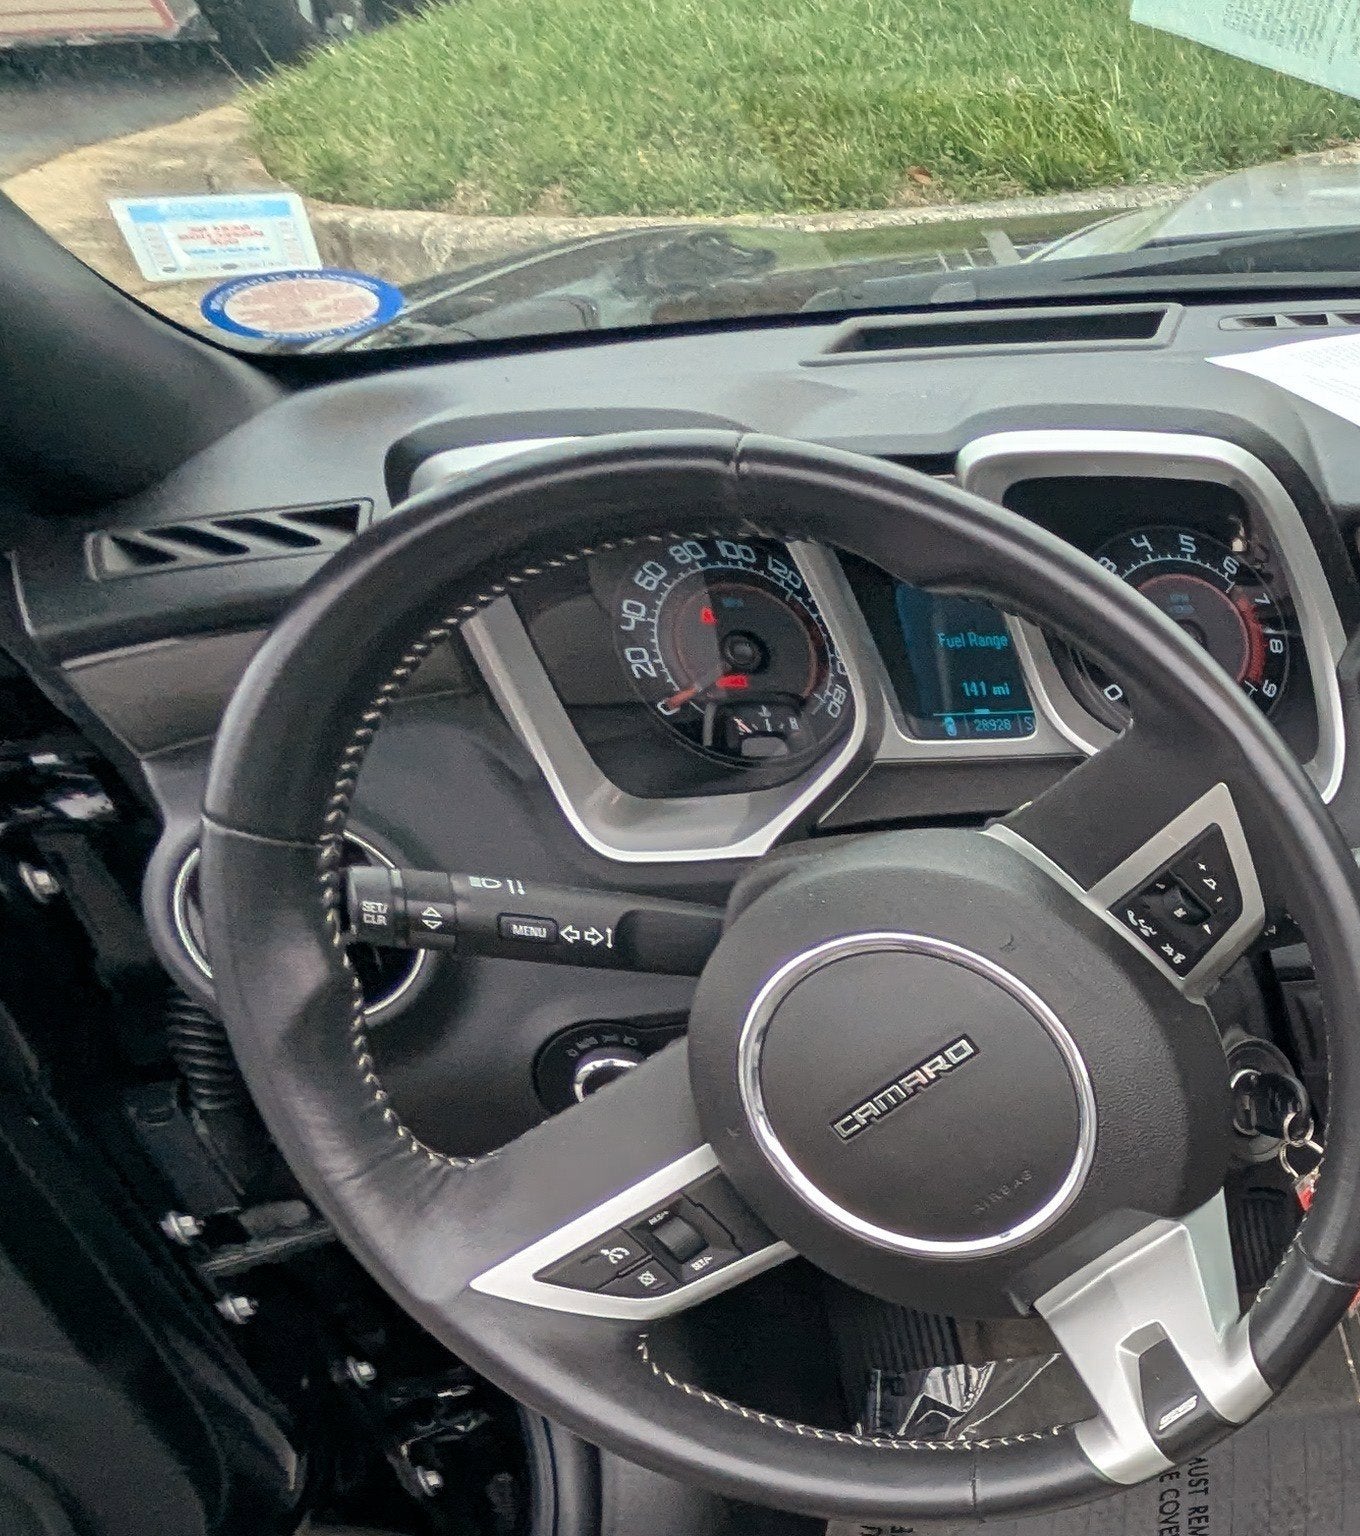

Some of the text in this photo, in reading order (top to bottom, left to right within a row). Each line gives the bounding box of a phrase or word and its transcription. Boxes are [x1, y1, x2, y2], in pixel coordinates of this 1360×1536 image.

[669, 540, 706, 564] 80
[716, 540, 756, 563] 100
[1130, 534, 1154, 552] 4
[1178, 533, 1196, 553] 5
[767, 556, 802, 590] 120
[1222, 555, 1241, 576] 6
[634, 561, 667, 591] 60
[1254, 594, 1271, 607] 7
[621, 599, 646, 632] 40
[938, 632, 1009, 650] Fuel Range
[1269, 638, 1284, 654] 8
[624, 646, 657, 680] 20
[992, 682, 1010, 696] mi
[1103, 683, 1123, 701] 0
[1262, 679, 1278, 698] 9
[828, 684, 848, 718] 180
[363, 914, 388, 926] CLR
[512, 924, 547, 938] MENU
[834, 1037, 975, 1139] CAMARO
